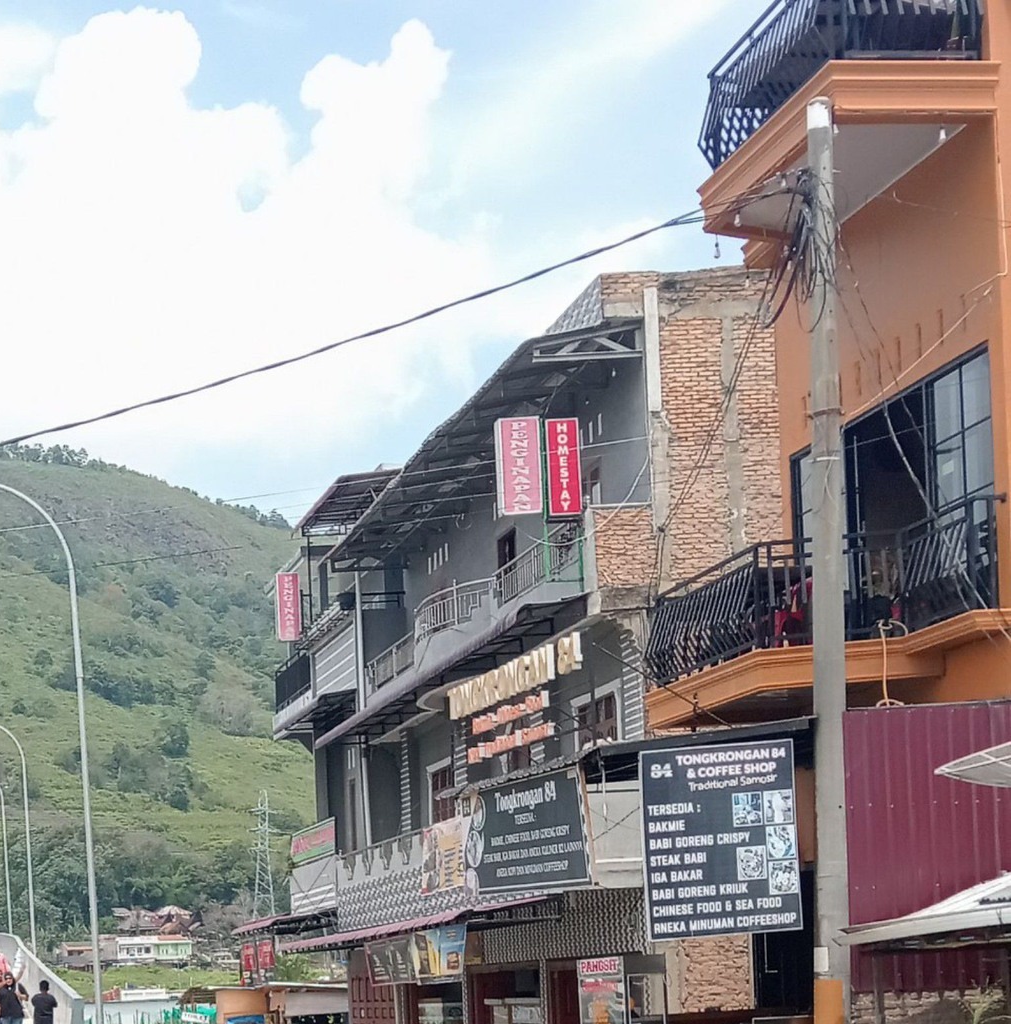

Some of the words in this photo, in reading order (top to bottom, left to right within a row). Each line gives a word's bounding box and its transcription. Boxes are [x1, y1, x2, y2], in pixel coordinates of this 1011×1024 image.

[510, 421, 531, 512] PENGINAPAN
[556, 422, 571, 511] HOMESTAY
[676, 748, 770, 766] TONGKRONGAN
[771, 747, 786, 758] 84
[686, 768, 696, 779] &
[697, 765, 742, 778] COFFEE
[744, 761, 777, 774] SHOP
[688, 778, 738, 792] Traditional
[740, 773, 778, 786] Samosir
[494, 788, 543, 814] Tongkrongan
[544, 780, 556, 802] 84
[647, 803, 694, 816] TERSEDIA
[648, 820, 685, 833] BAKMIE
[649, 838, 672, 850] BABI
[675, 834, 714, 848] GORENG
[717, 832, 751, 845] CRISPY
[650, 854, 681, 867] STEAK
[684, 852, 707, 865] BABI
[651, 872, 668, 884] IGA
[670, 869, 703, 882] BAKAR
[652, 888, 675, 901] BABI
[678, 885, 716, 899] GORENG
[720, 883, 748, 895] KRIUK
[653, 903, 694, 917] CHINESE
[697, 901, 722, 914] FOOD
[735, 899, 754, 911] SEA
[757, 897, 782, 909] FOOD
[689, 917, 734, 931] MINUMAN
[737, 912, 797, 928] COFFEESHOP
